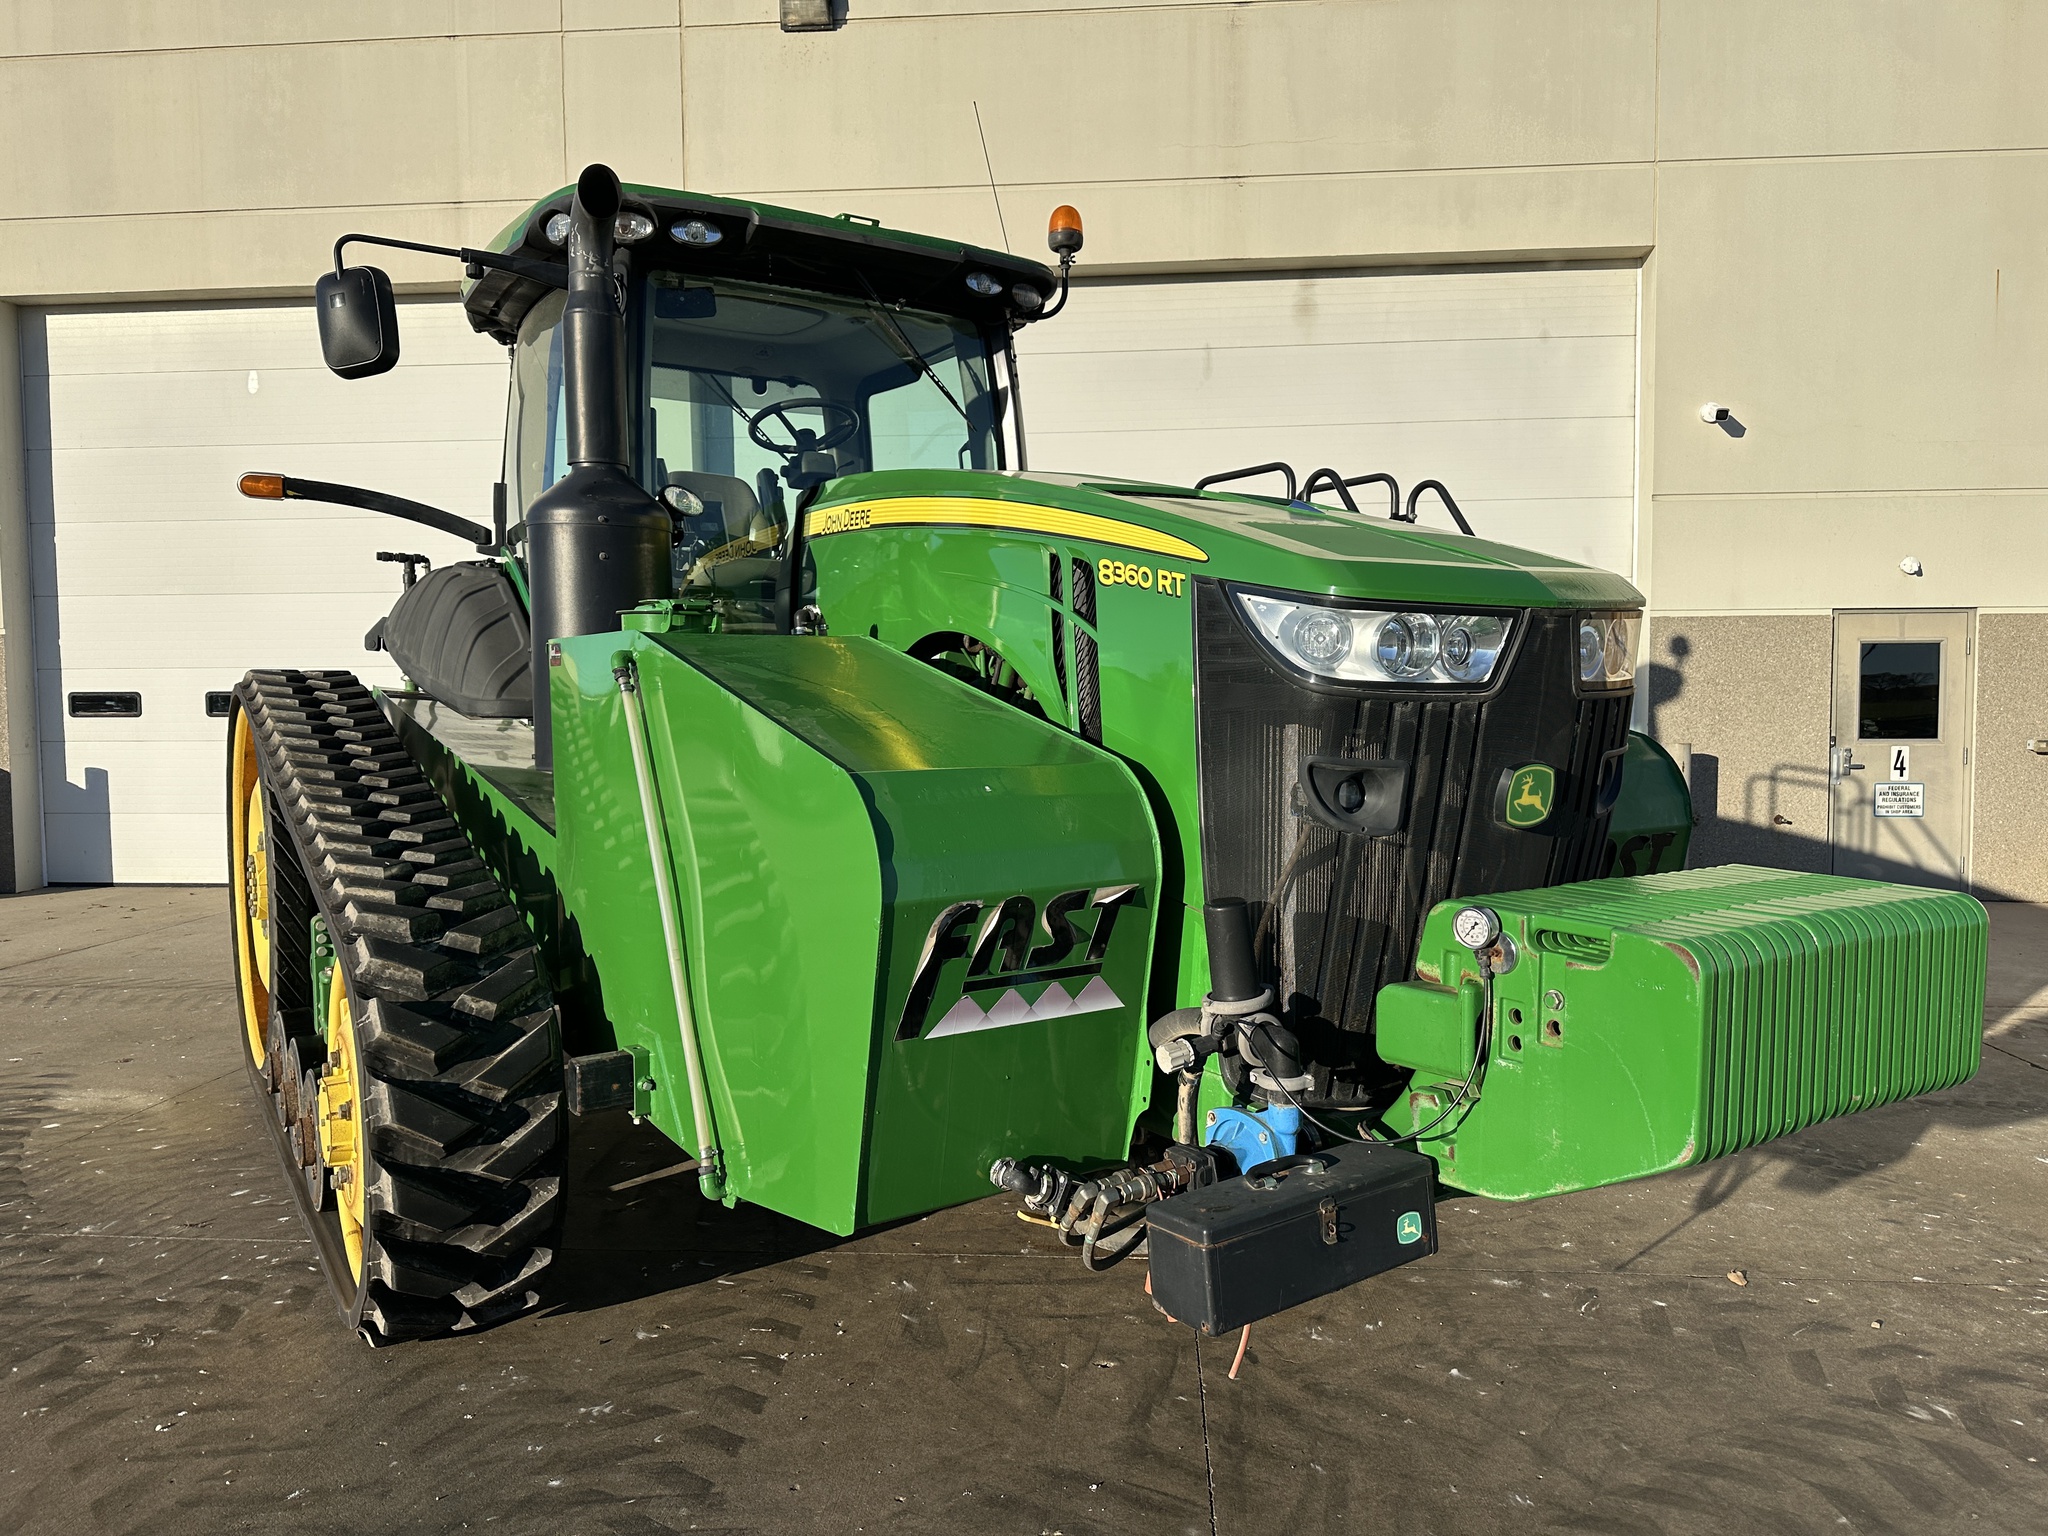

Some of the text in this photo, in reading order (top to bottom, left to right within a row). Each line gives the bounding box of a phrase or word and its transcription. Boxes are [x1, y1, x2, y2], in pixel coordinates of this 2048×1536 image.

[822, 508, 871, 532] JOHN DEERE
[1098, 558, 1186, 598] 8360 RT
[1893, 749, 1906, 777] 4
[1600, 831, 1677, 878] ST
[893, 883, 1140, 1043] FAST
